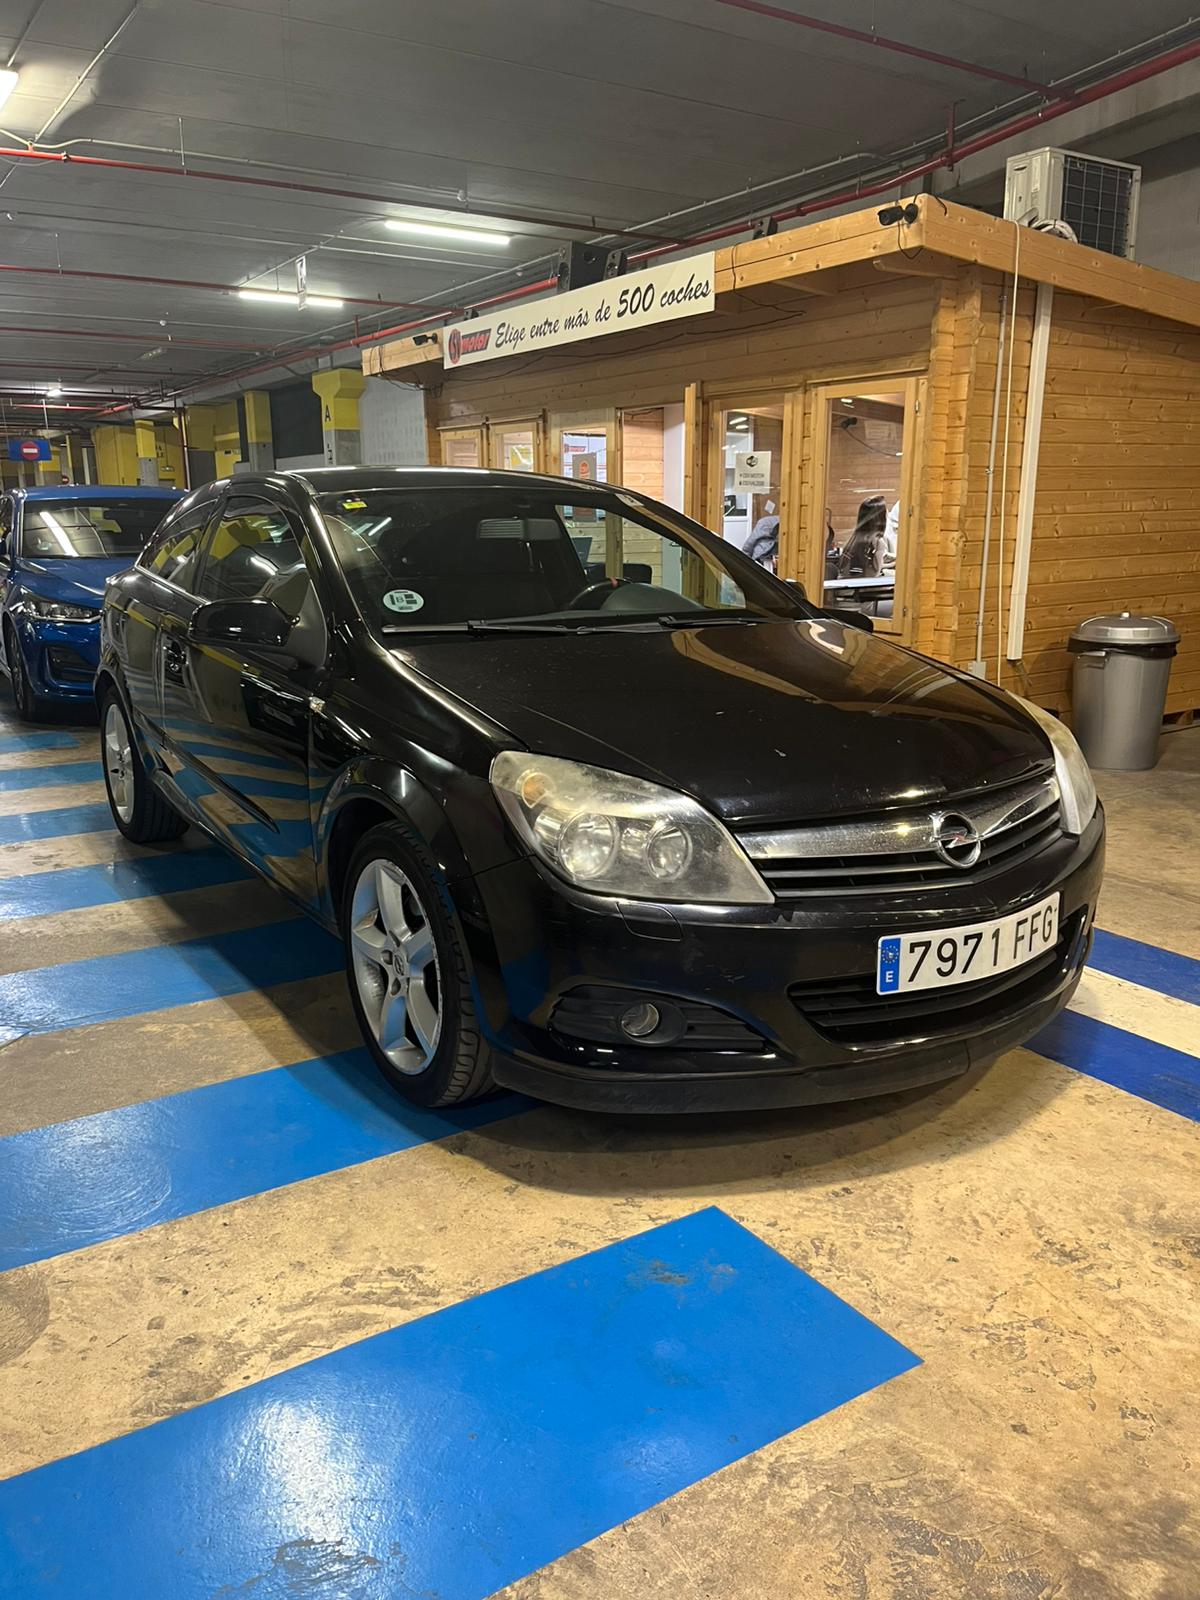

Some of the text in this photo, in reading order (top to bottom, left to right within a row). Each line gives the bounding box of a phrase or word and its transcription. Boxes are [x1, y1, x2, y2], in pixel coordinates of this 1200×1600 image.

[495, 322, 526, 350] Elige
[530, 317, 560, 339] entre
[564, 308, 590, 331] más
[595, 299, 611, 322] de
[617, 283, 655, 318] 500
[660, 273, 712, 308] coches
[324, 404, 332, 422] A
[885, 905, 1053, 983] E 7971 FFG
